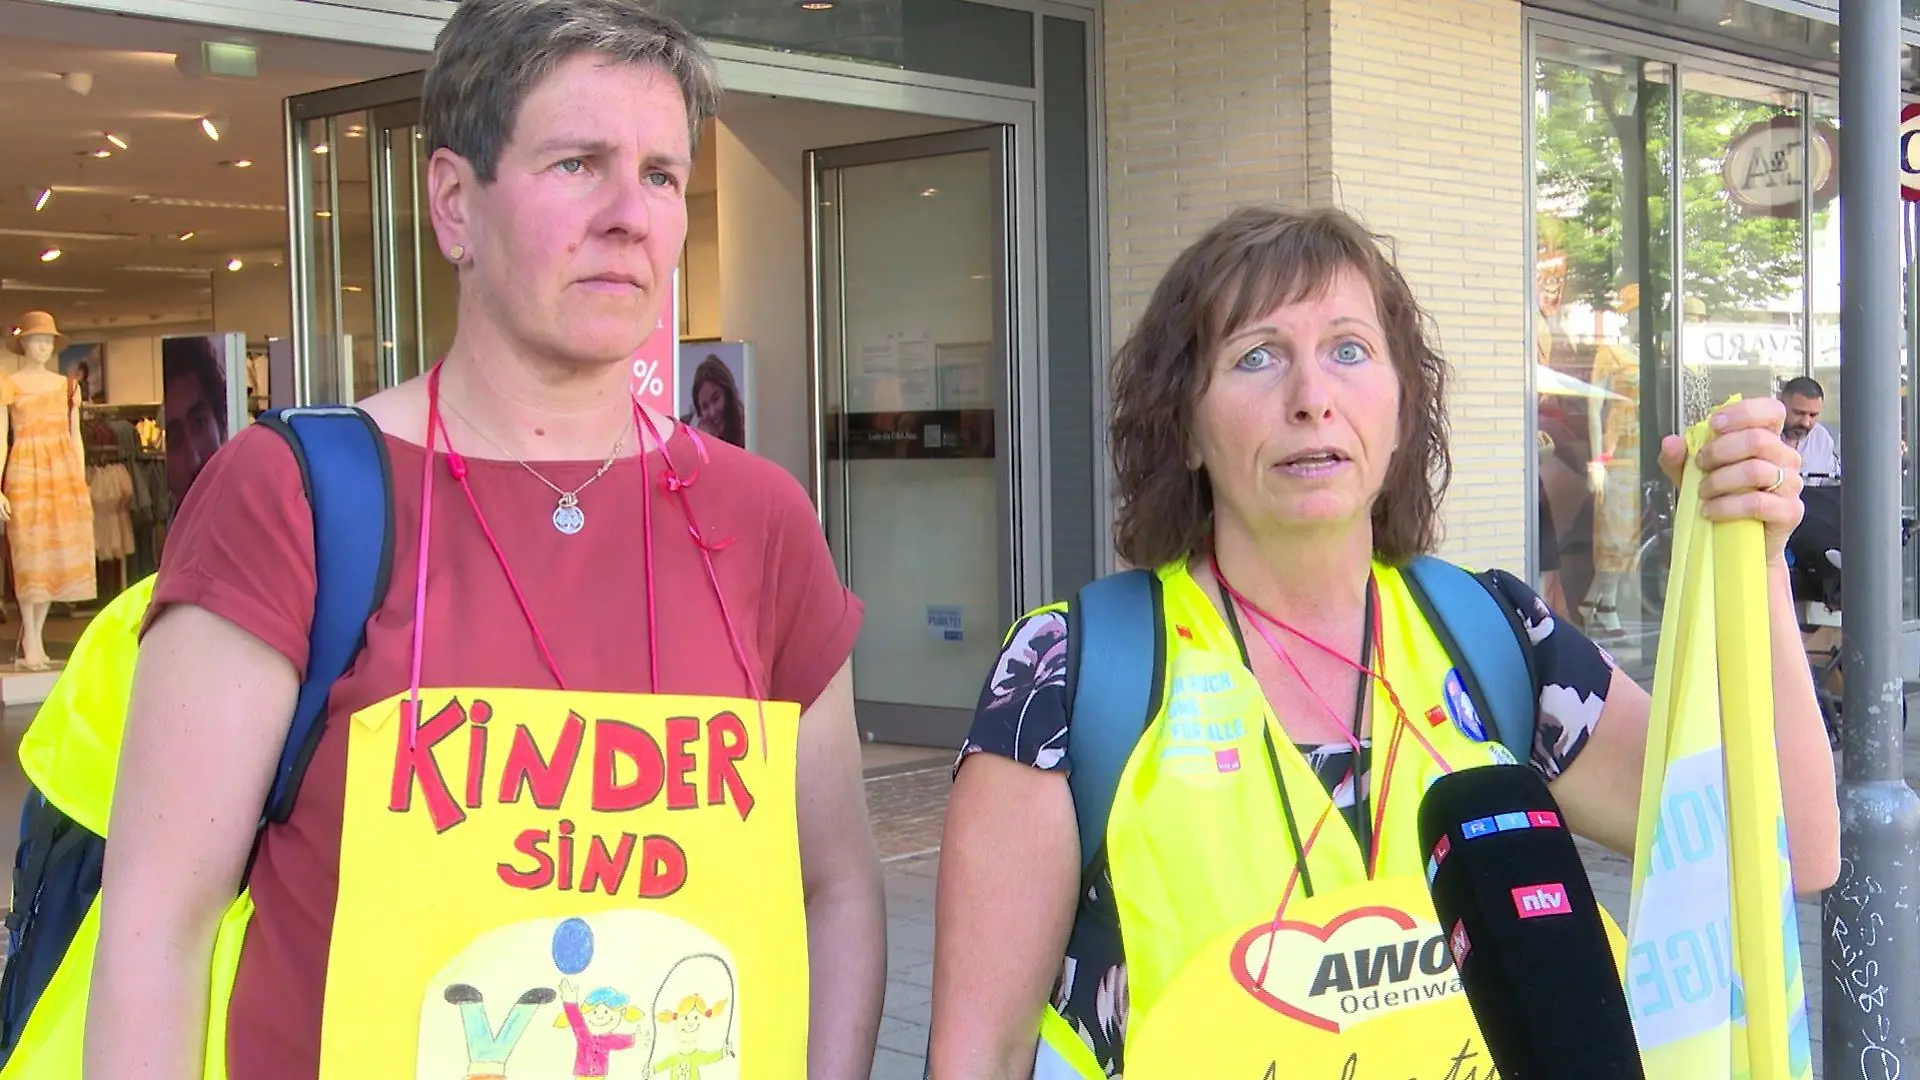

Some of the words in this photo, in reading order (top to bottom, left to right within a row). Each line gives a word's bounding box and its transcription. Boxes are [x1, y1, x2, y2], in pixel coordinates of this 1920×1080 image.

[1521, 888, 1562, 911] ntv
[1309, 933, 1454, 997] AWO
[1339, 977, 1465, 1014] Odenwa
